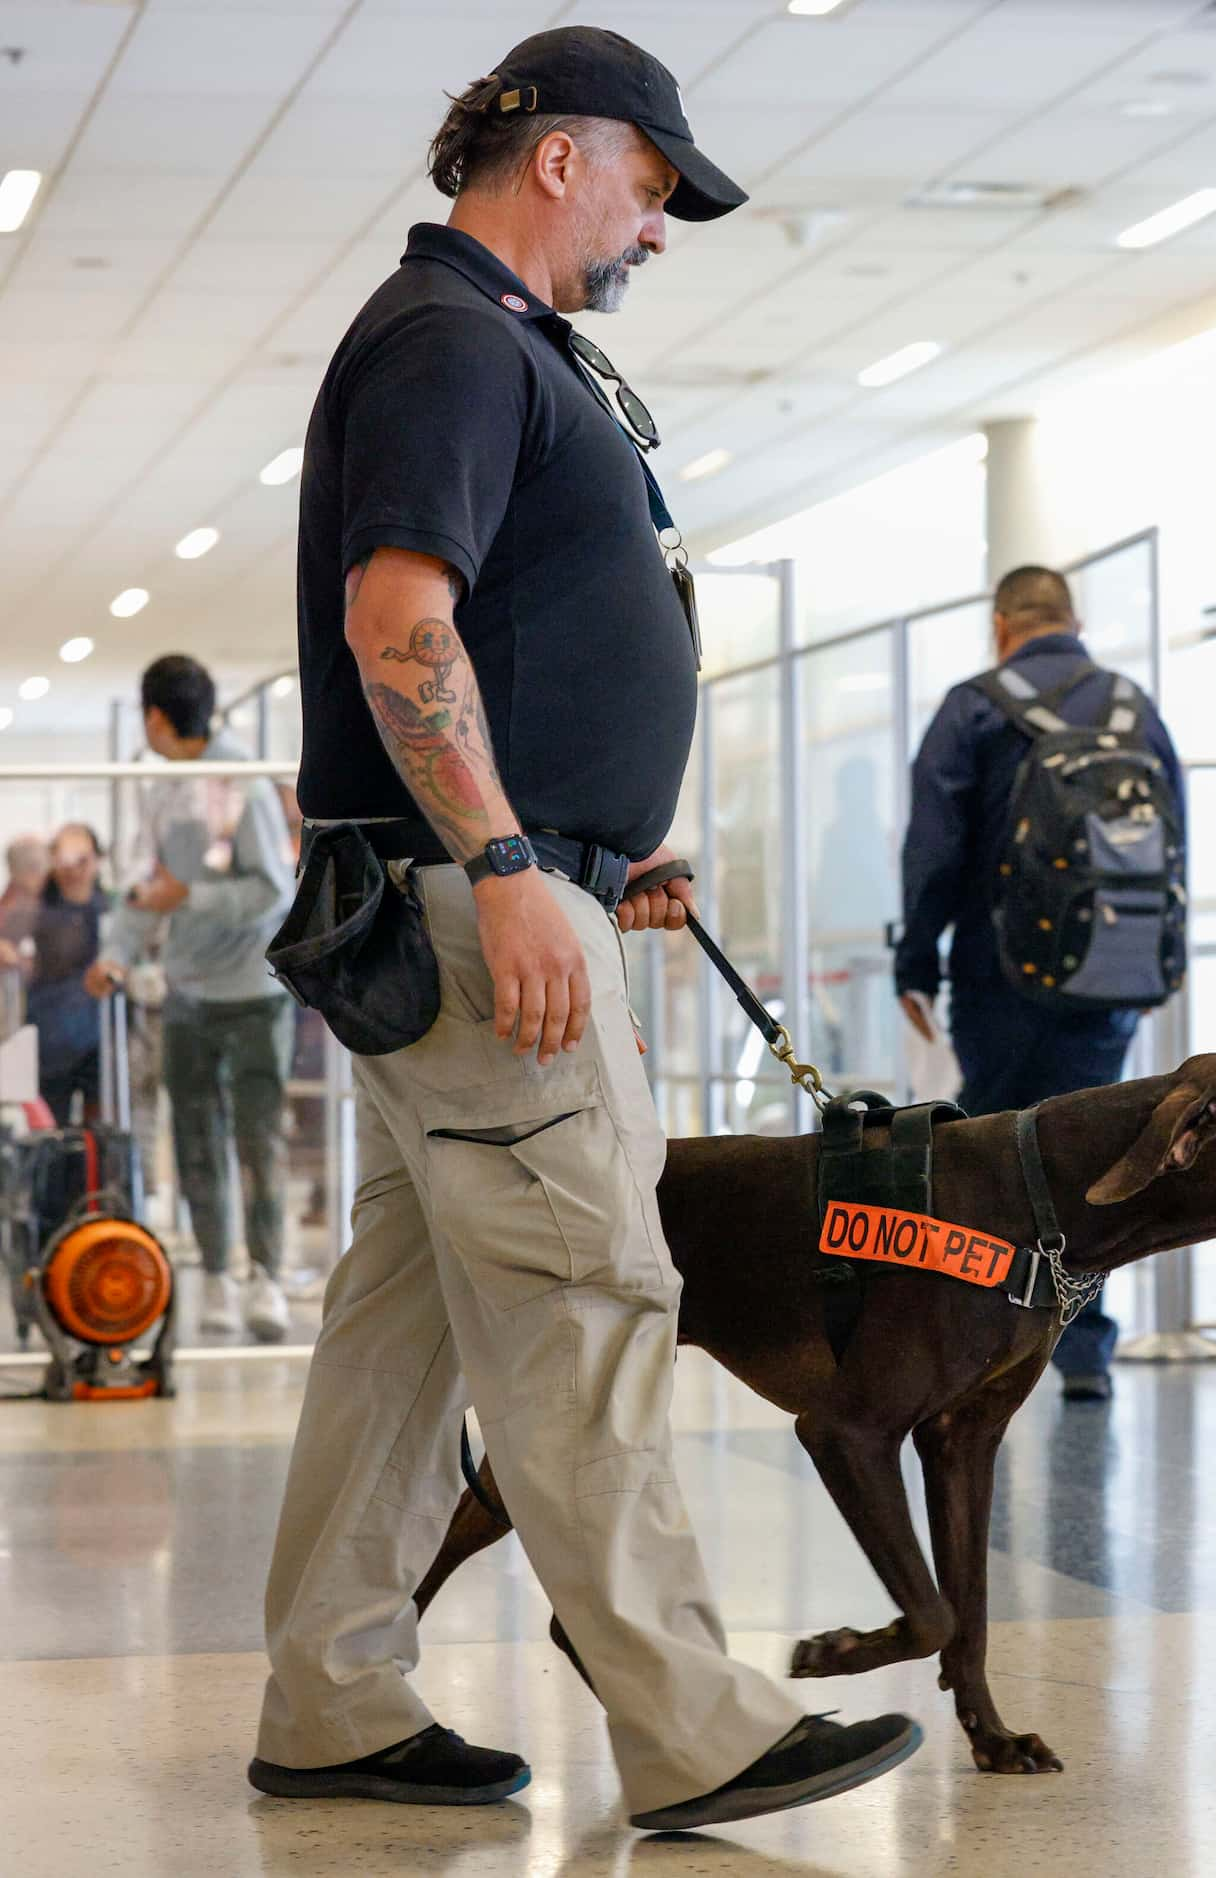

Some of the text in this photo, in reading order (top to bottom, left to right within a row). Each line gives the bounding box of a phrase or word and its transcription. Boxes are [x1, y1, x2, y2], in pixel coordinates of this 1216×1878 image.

[827, 1208, 1007, 1279] DO NOT PET
